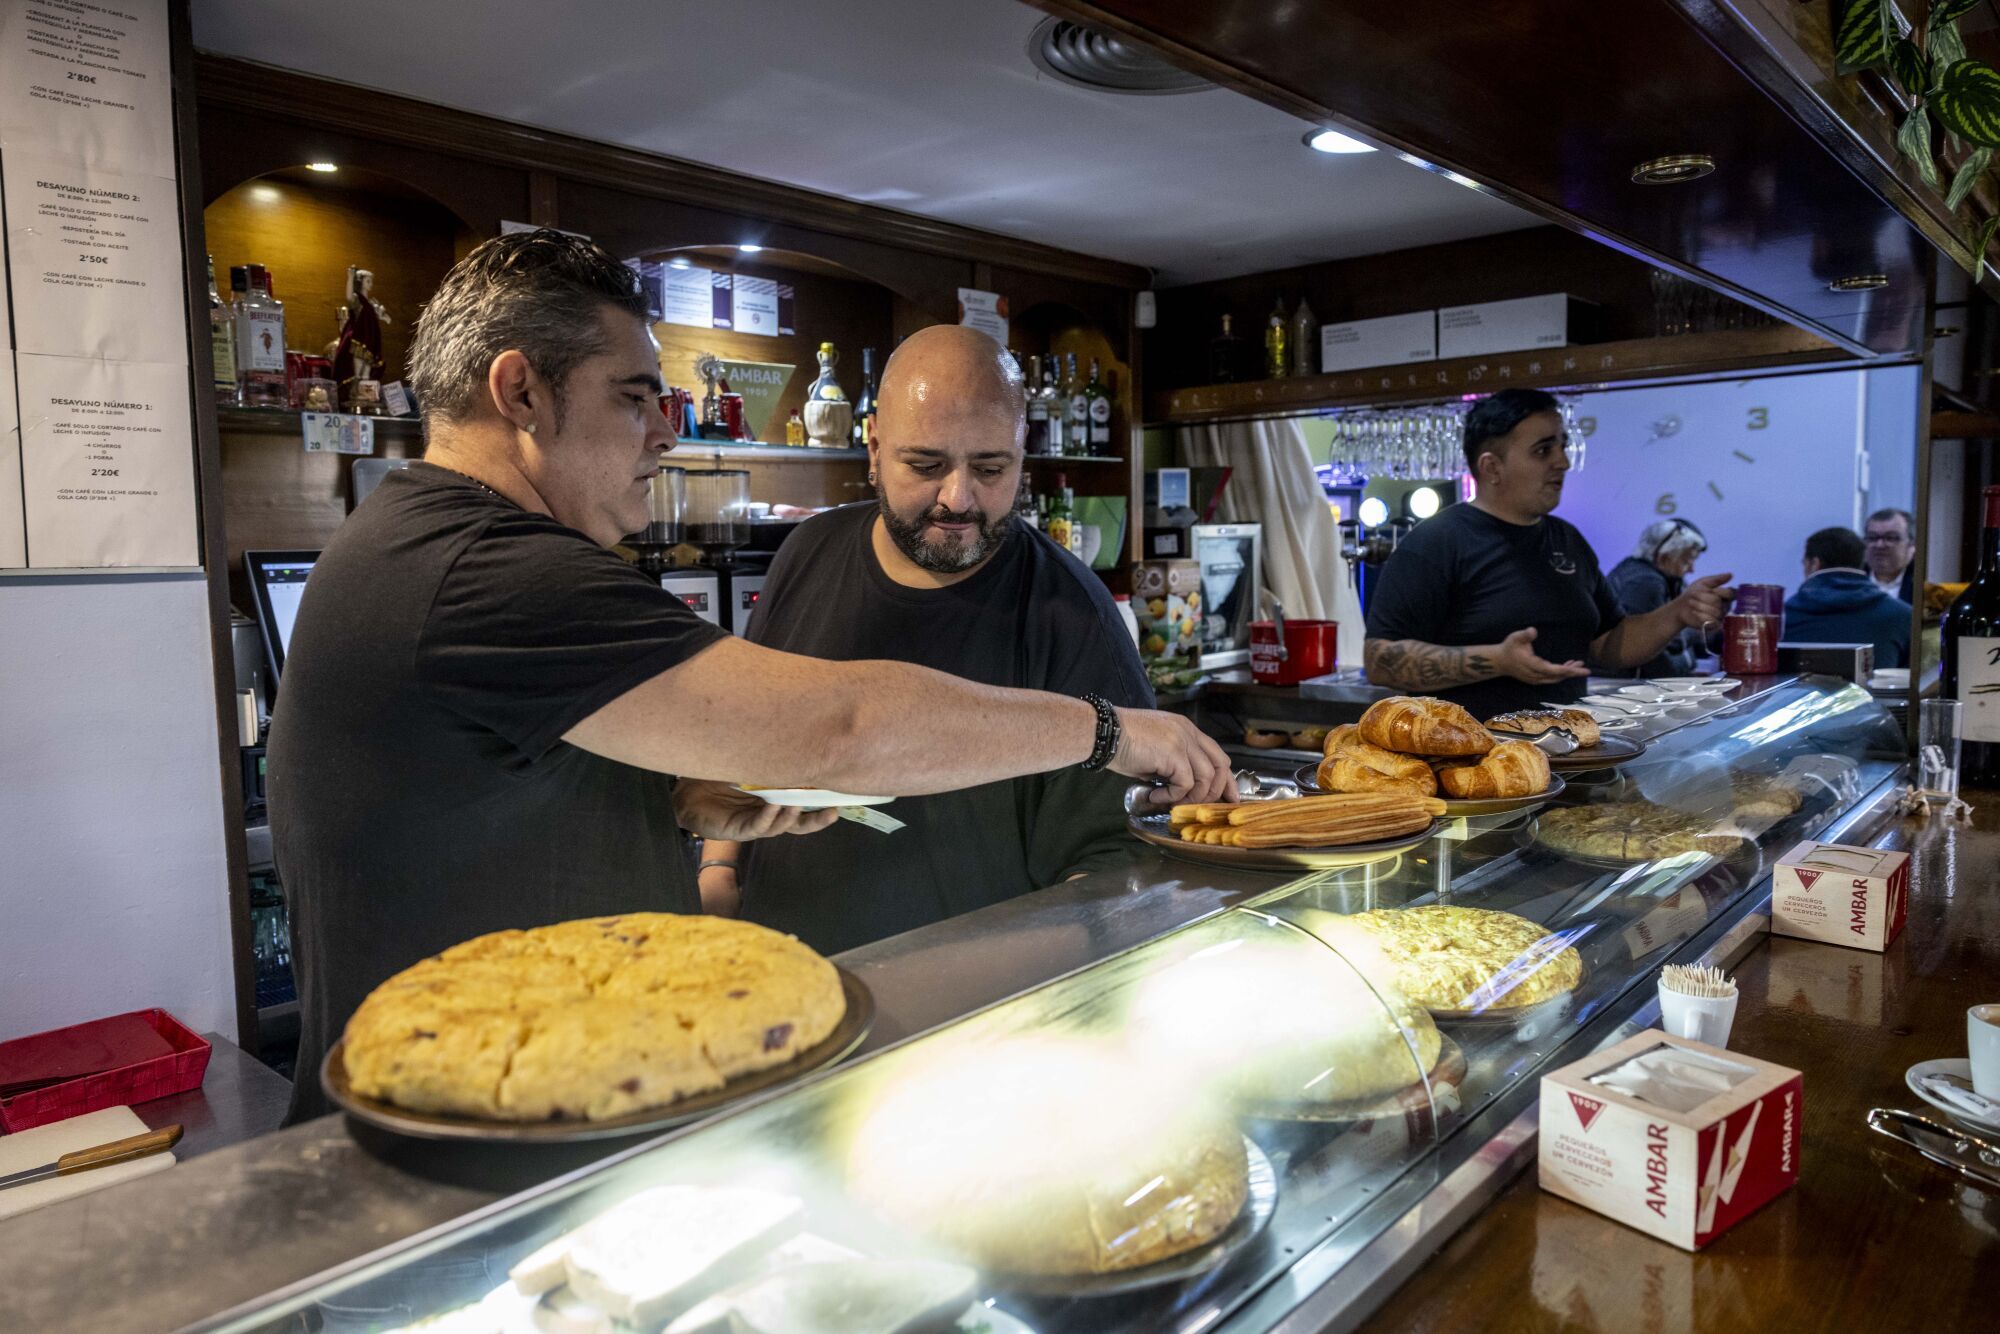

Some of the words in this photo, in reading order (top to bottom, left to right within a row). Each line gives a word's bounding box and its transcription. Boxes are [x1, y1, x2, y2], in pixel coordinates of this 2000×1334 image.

[30, 91, 47, 99] COLA
[66, 92, 80, 100] CON
[81, 96, 102, 104] LECHE
[103, 100, 128, 109] GRANDE
[36, 181, 86, 195] DESAYUNO
[89, 188, 130, 200] NÚMERO
[58, 205, 75, 213] SOLO
[83, 209, 112, 218] CORTADO
[66, 213, 97, 222] INFUSIÓN
[79, 254, 109, 264] 2'50€
[729, 367, 783, 385] AMBAR
[51, 398, 101, 407] DESAYUNO
[103, 400, 143, 410] NÚMERO
[324, 416, 340, 428] 20
[1747, 407, 1769, 430] 3
[310, 441, 321, 450] 20
[91, 468, 120, 477] 2'20€
[1655, 492, 1677, 515] 6
[1798, 870, 1817, 878] 1900
[1783, 900, 1826, 911] CERVECEROS
[1788, 895, 1823, 905] PEQUEÑOS
[1850, 878, 1868, 936] AMBAR
[1793, 908, 1828, 918] CERVEZÓN
[1572, 1095, 1598, 1111] 1900
[1559, 1133, 1607, 1157] PEQUEÑOS
[1781, 1104, 1794, 1172] AMBAR
[1554, 1141, 1612, 1168] CERVECEROS
[1567, 1155, 1614, 1178] CERVEZÓN
[1646, 1123, 1669, 1219] AMBAR
